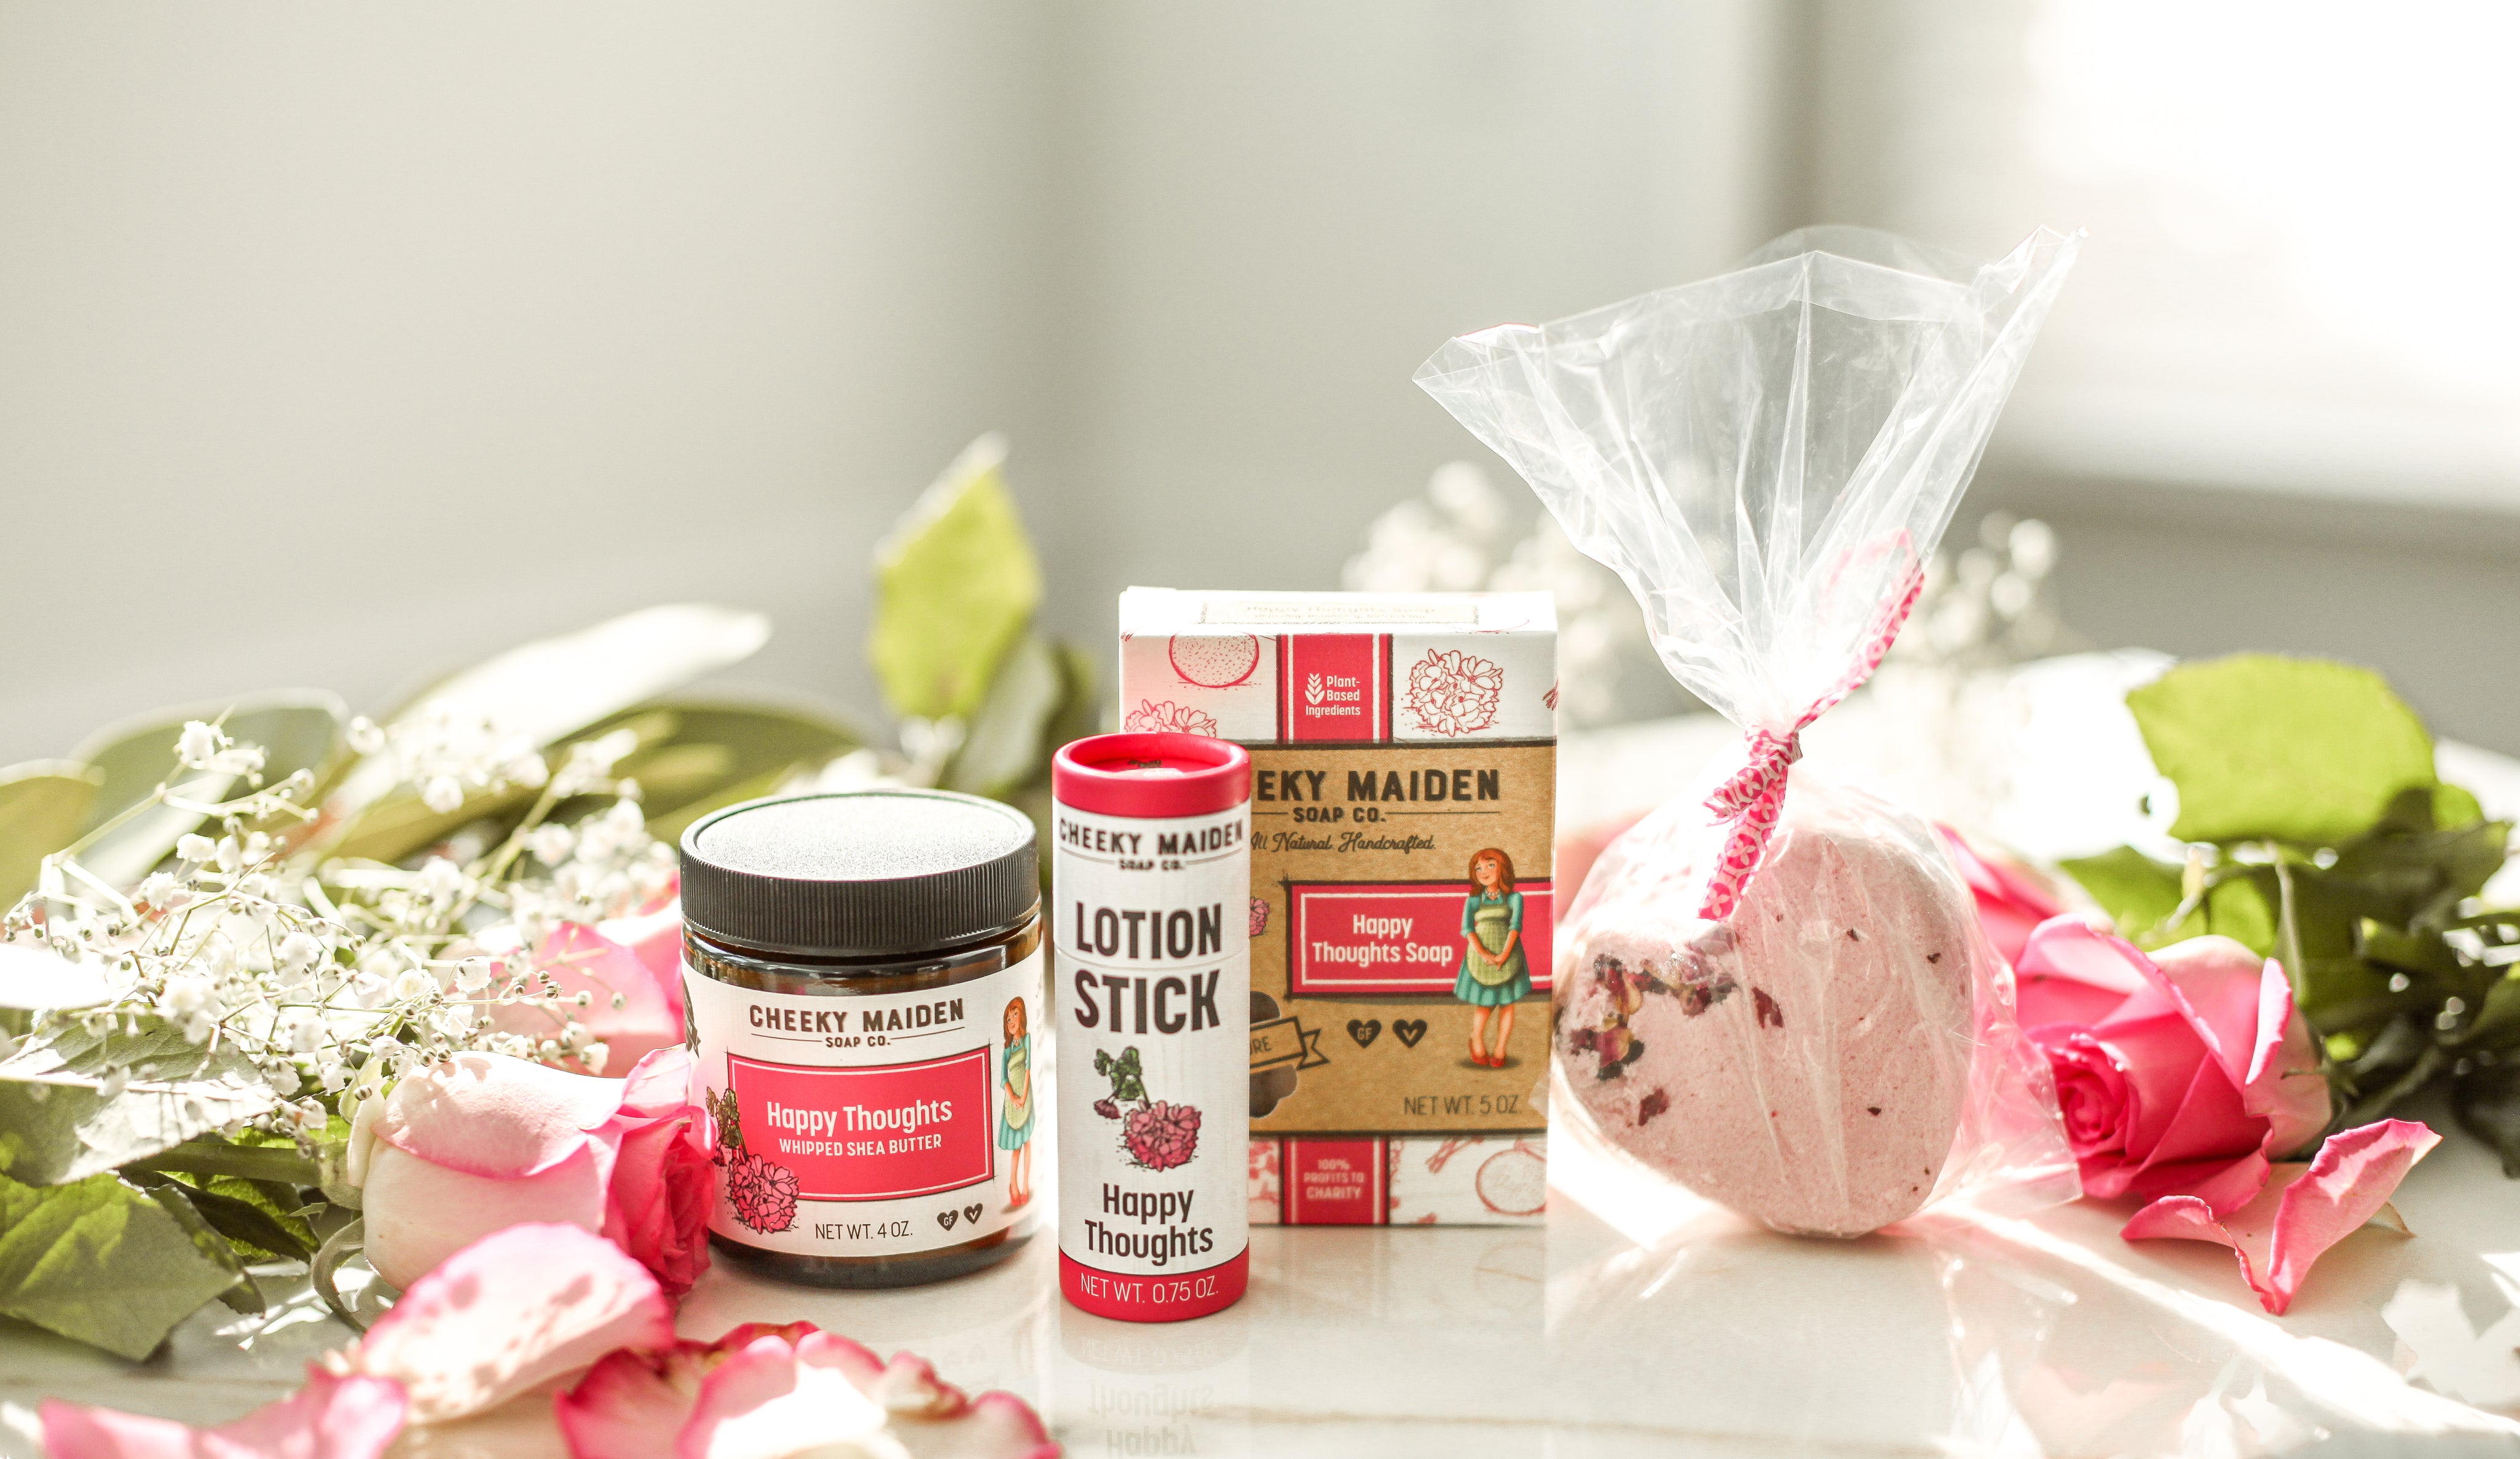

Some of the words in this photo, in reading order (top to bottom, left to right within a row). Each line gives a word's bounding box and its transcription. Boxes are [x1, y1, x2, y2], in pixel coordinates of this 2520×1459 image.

[1326, 675, 1360, 688] Plant-
[1326, 690, 1360, 702] Based
[1305, 705, 1360, 718] Ingredients
[1257, 770, 1326, 802] EKY
[1347, 769, 1500, 802] MAIDEN
[1293, 807, 1344, 823] SOAP
[1352, 807, 1387, 823] CO.
[1059, 818, 1141, 855] CHEEKY
[1158, 818, 1243, 855] MAIDEN
[1338, 831, 1436, 855] Handcrafted.
[1119, 858, 1154, 871] SOAP
[1161, 859, 1186, 871] CO.
[1076, 901, 1222, 960] LOTION
[1353, 914, 1413, 939] Happy
[1312, 942, 1401, 967] Thoughts
[1405, 943, 1453, 967] Soap
[1074, 968, 1221, 1035] STICK
[749, 1004, 848, 1033] CHEEKY
[862, 998, 964, 1032] MAIDEN
[825, 1036, 860, 1048] SOAP
[867, 1035, 891, 1047] CO.
[1404, 1096, 1438, 1115] NET
[1443, 1095, 1475, 1115] WT.
[1479, 1095, 1492, 1115] 5
[1495, 1094, 1522, 1115] OZ.
[766, 1101, 838, 1137] Happy
[843, 1099, 953, 1133] Thoughts
[779, 1138, 843, 1157] WHIPPED
[847, 1137, 886, 1157] SHEA
[889, 1133, 942, 1155] BUTTER
[1303, 1171, 1349, 1184] PROFITS
[1352, 1171, 1364, 1184] TO
[1102, 1182, 1195, 1224] Happy
[1306, 1186, 1361, 1201] CHARITY
[815, 1223, 843, 1240] NET
[847, 1223, 874, 1240] WT.
[876, 1222, 888, 1237] 4
[890, 1220, 913, 1238] OZ.
[943, 1214, 955, 1227] GF
[1084, 1219, 1214, 1267] Thoughts
[1081, 1272, 1108, 1299] NET
[1114, 1281, 1146, 1303] WT.
[1152, 1282, 1191, 1303] 0.75
[1195, 1275, 1219, 1299] OZ.
